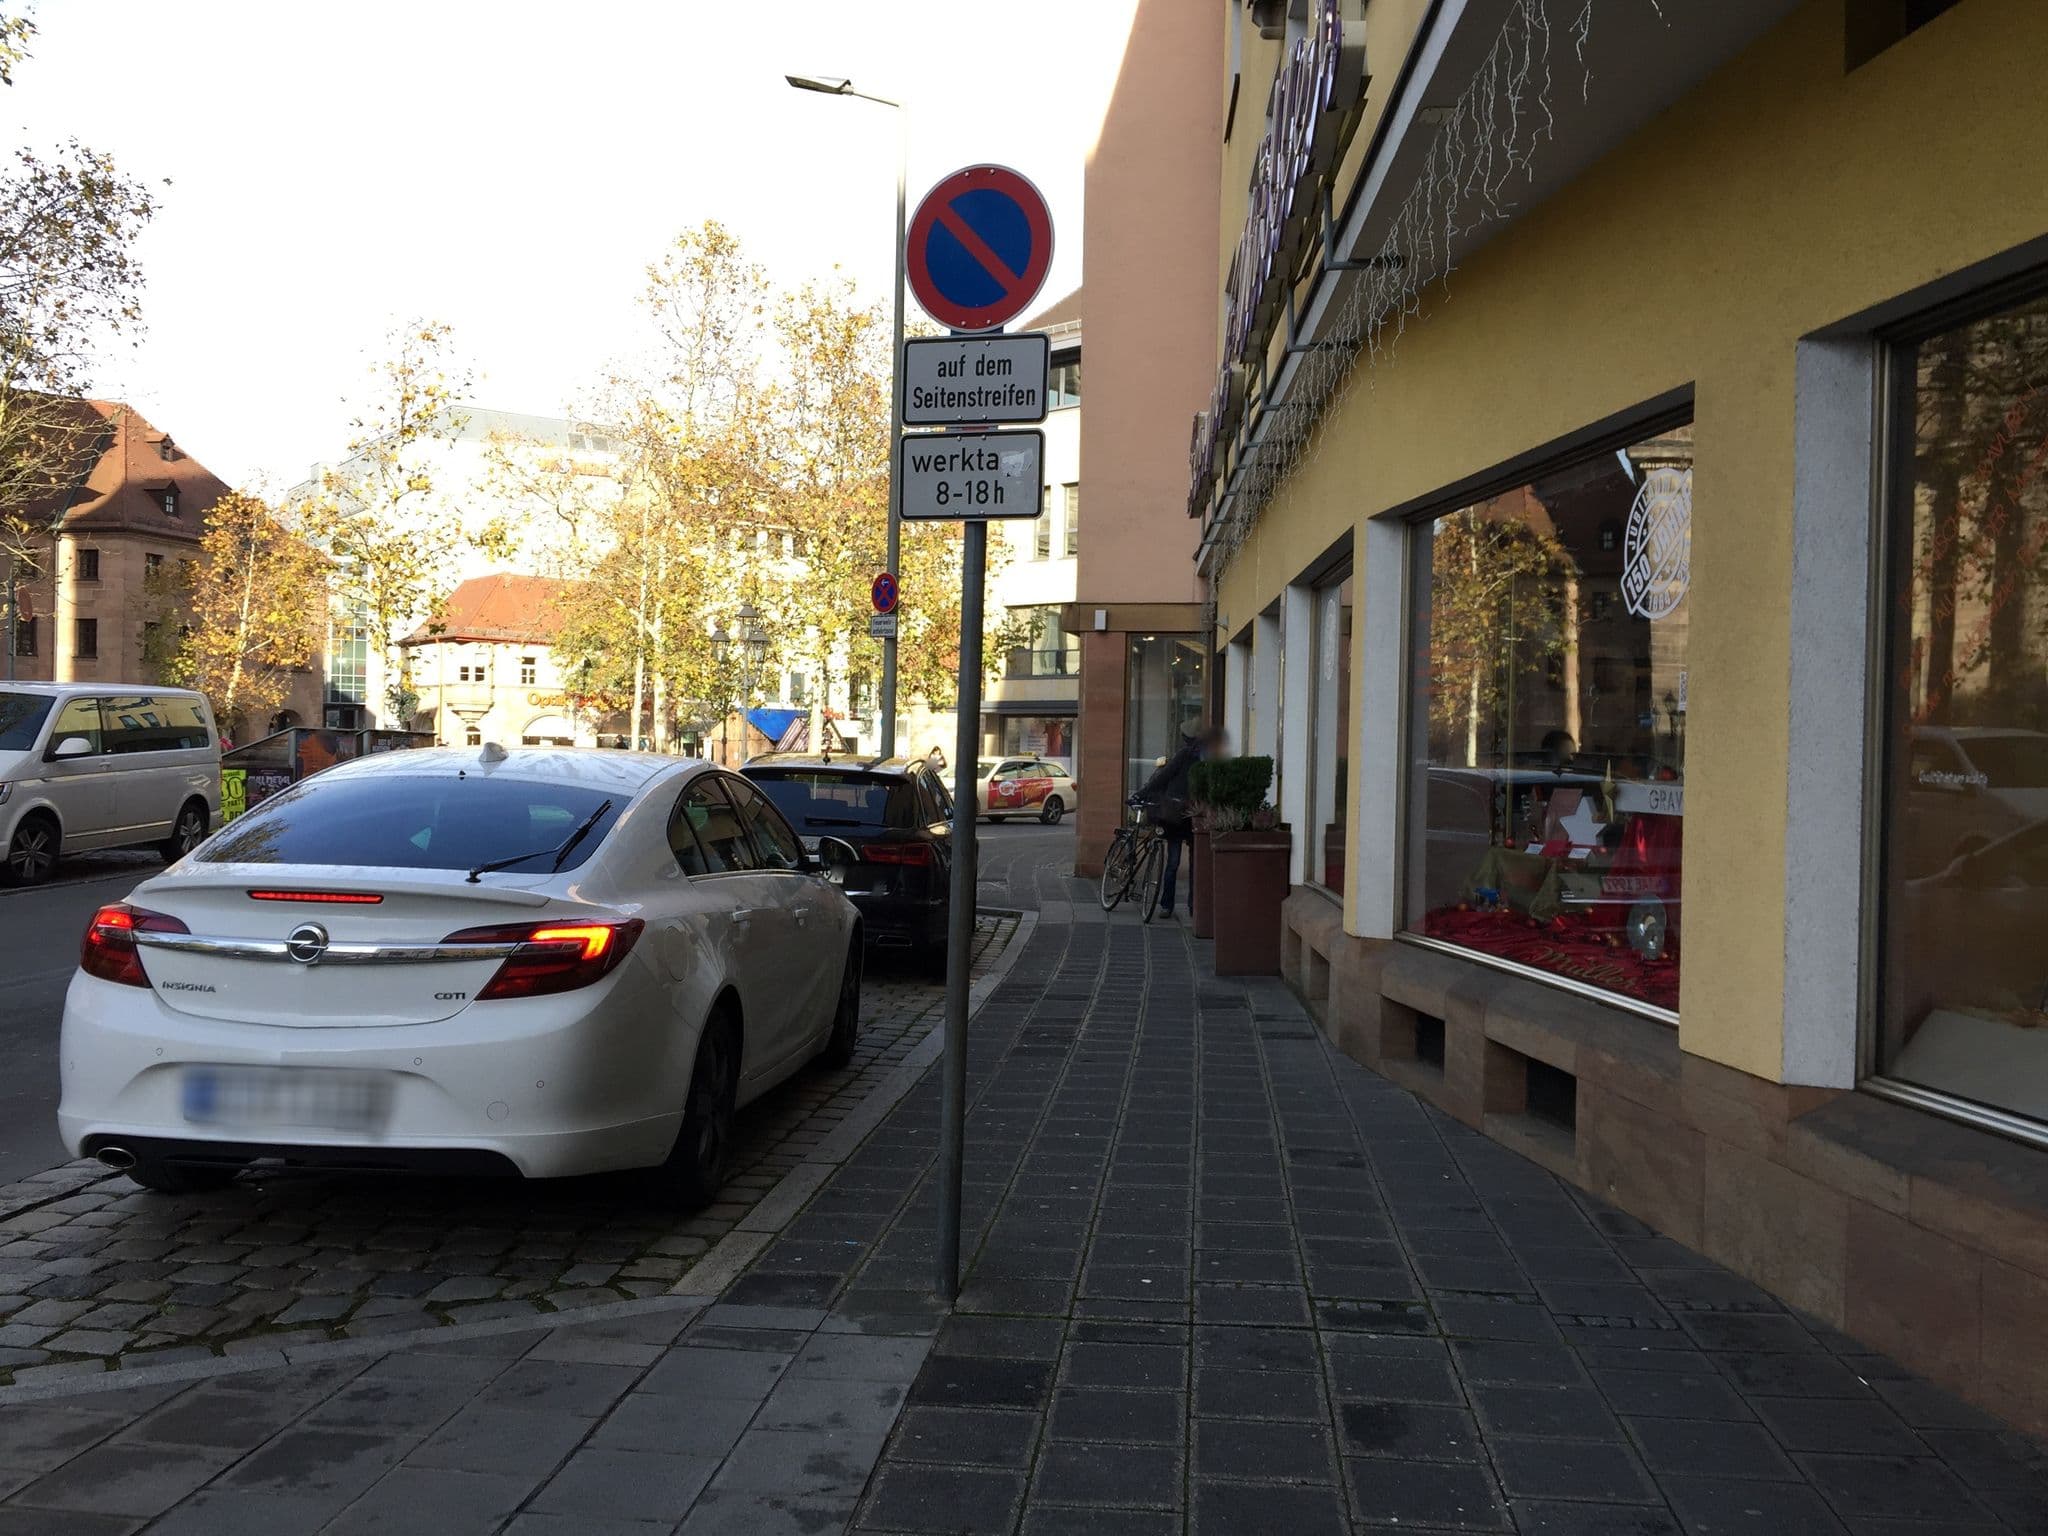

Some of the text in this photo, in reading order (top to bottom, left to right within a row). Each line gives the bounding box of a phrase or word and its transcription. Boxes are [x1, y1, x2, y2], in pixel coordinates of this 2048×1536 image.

[937, 353, 1012, 378] auf dem
[913, 383, 1036, 410] Seitenstreifen
[911, 446, 1008, 476] werkta
[1626, 554, 1652, 602] 150
[1649, 789, 1684, 811] GRAV
[162, 981, 217, 993] INSIGNIA
[434, 992, 466, 1001] CDTI
